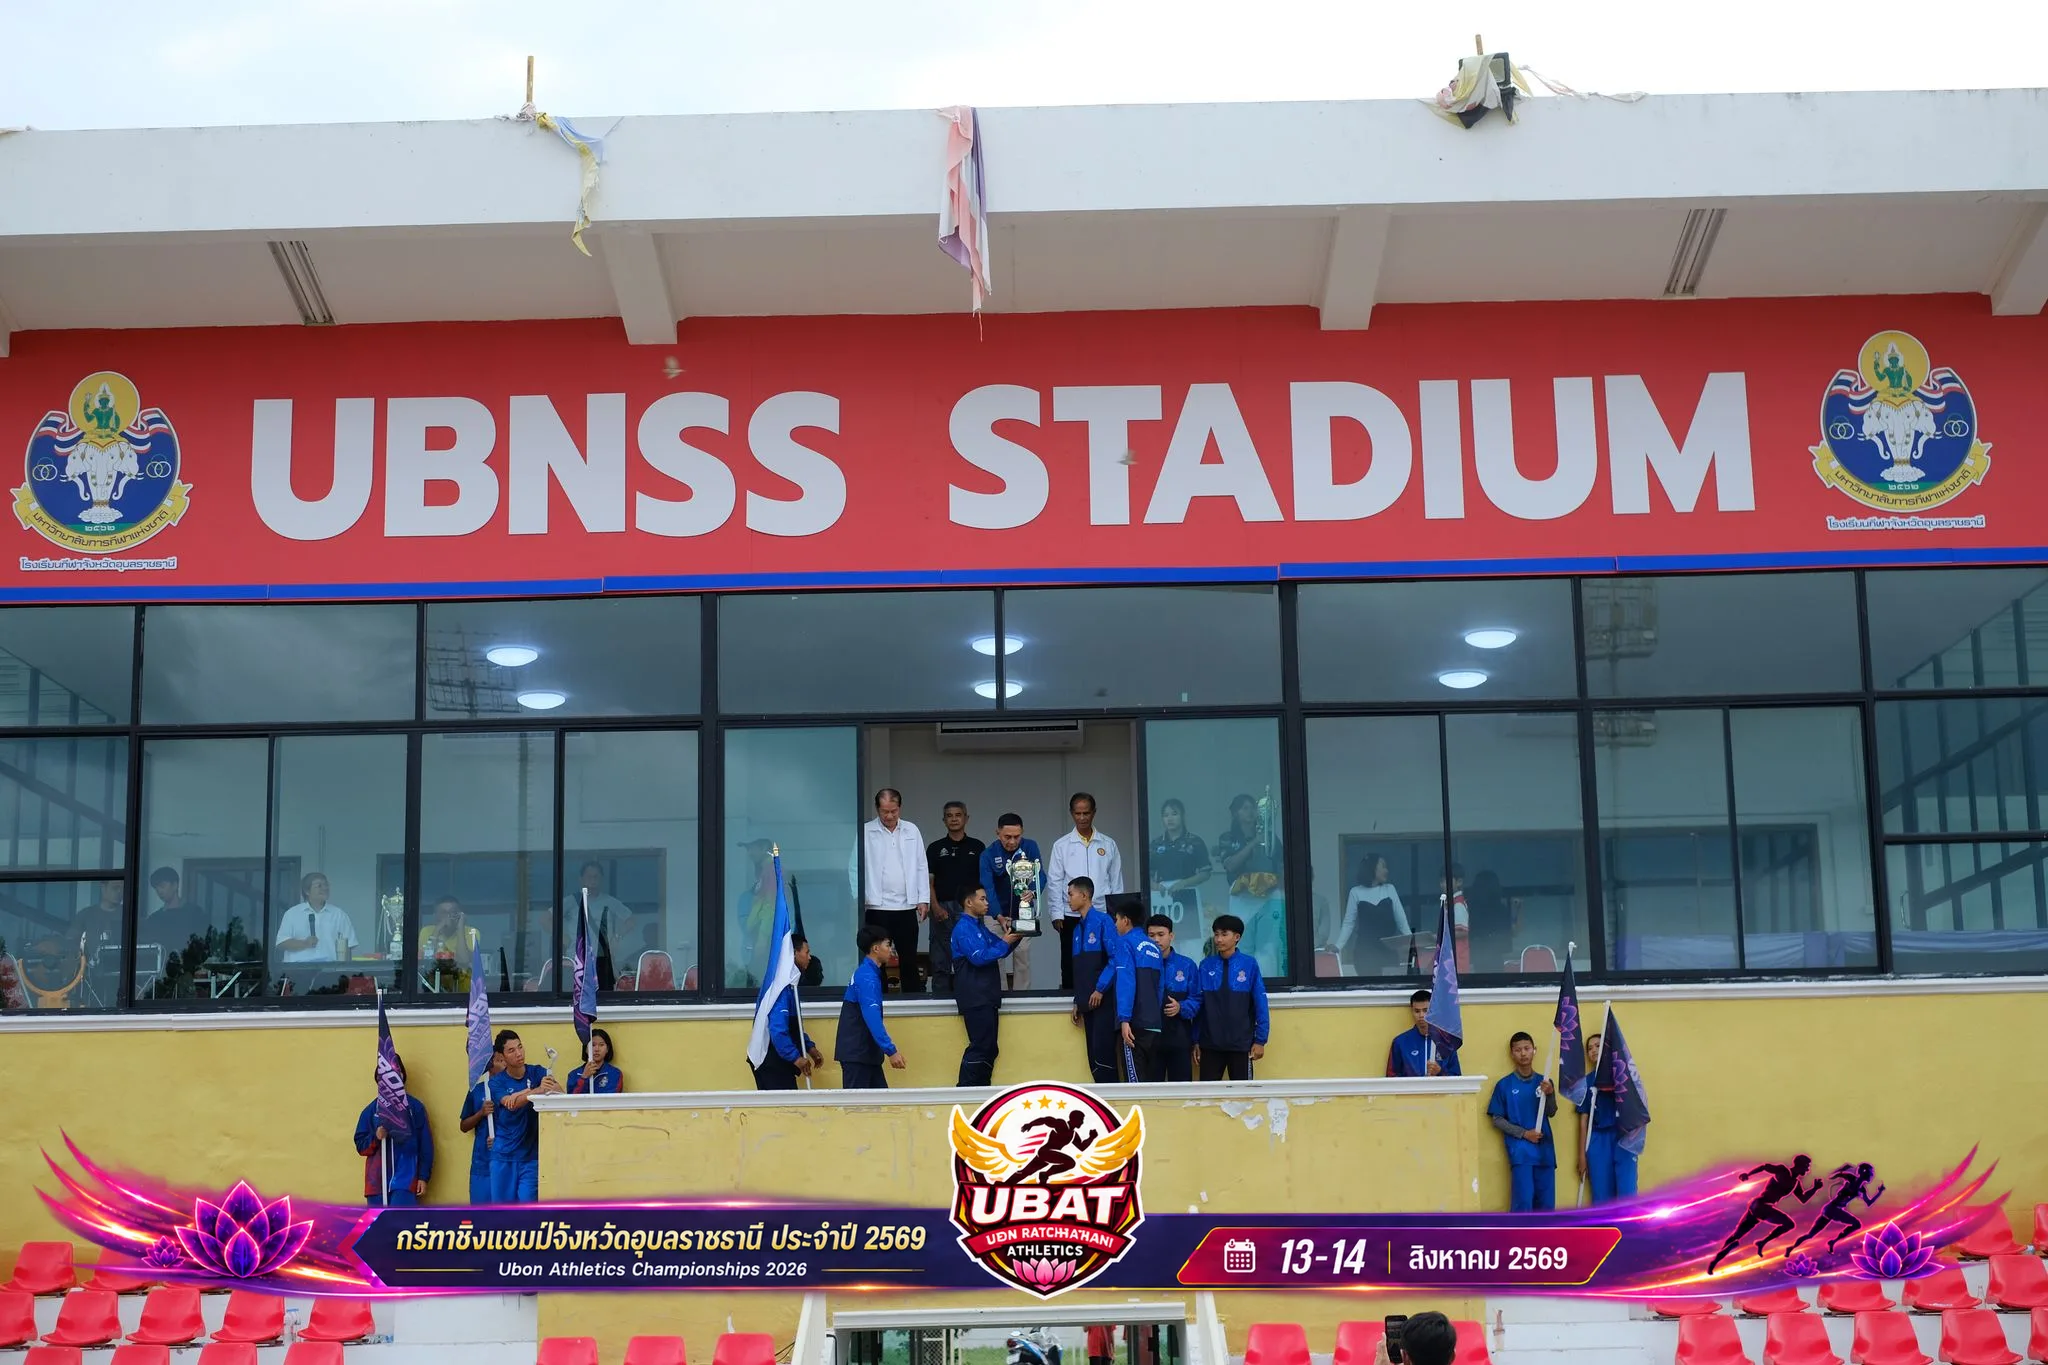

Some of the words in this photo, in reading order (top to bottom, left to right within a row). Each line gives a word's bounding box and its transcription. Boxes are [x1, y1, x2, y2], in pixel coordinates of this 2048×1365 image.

[250, 391, 847, 541] UBNSS
[948, 371, 1756, 530] STADIUM
[1827, 516, 1985, 530] โรงเรียนกีฬาจังหวัดอุบลราชธานี
[21, 558, 176, 572] โรงเรียนกีฬาจังหวัดอุบลราชธานี
